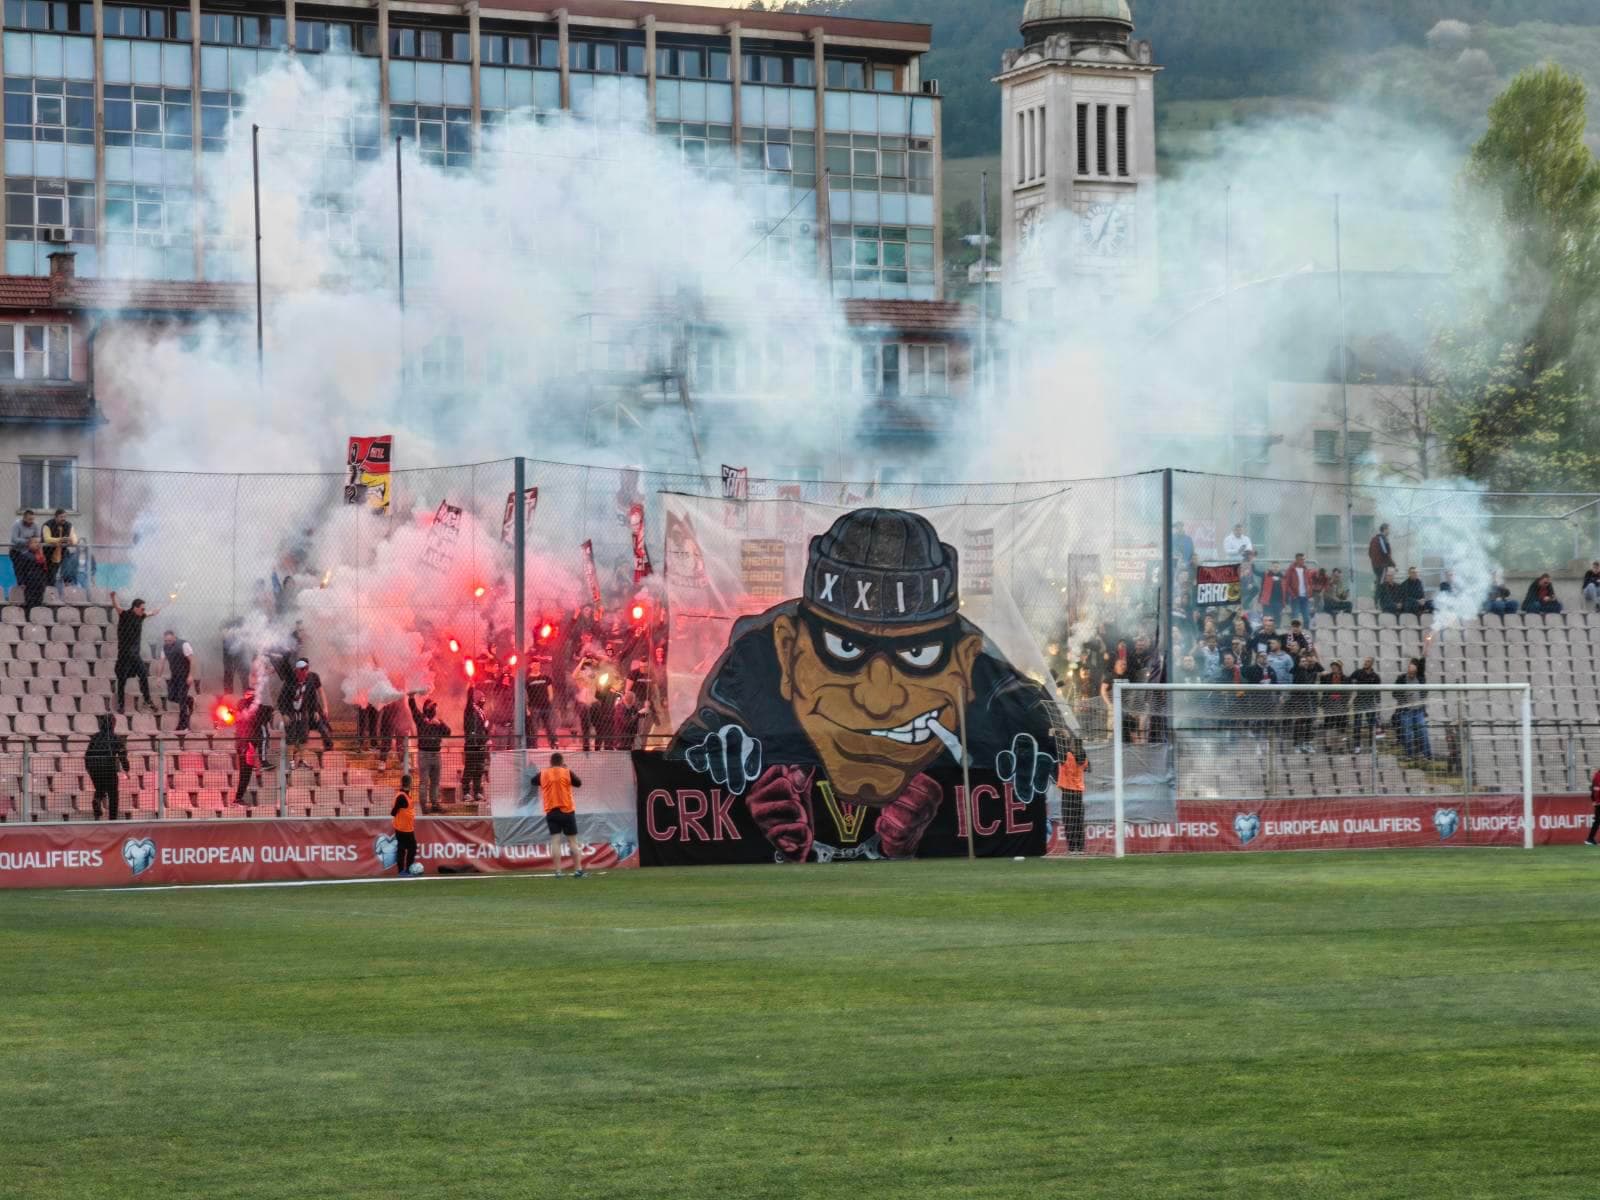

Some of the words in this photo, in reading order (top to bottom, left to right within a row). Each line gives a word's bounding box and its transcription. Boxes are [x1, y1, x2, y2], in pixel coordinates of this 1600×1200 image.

[646, 788, 742, 841] CRK
[954, 782, 1033, 837] ICE
[1056, 824, 1135, 840] EOPEN
[1138, 822, 1219, 838] QUALIFIERS
[1264, 819, 1339, 835] EUROPEAN
[1343, 817, 1422, 833] QUALIFIERS
[0, 850, 103, 870] QUALIFIERS
[161, 846, 255, 864] EUROPEAN
[261, 845, 358, 863] QUALIFIERS
